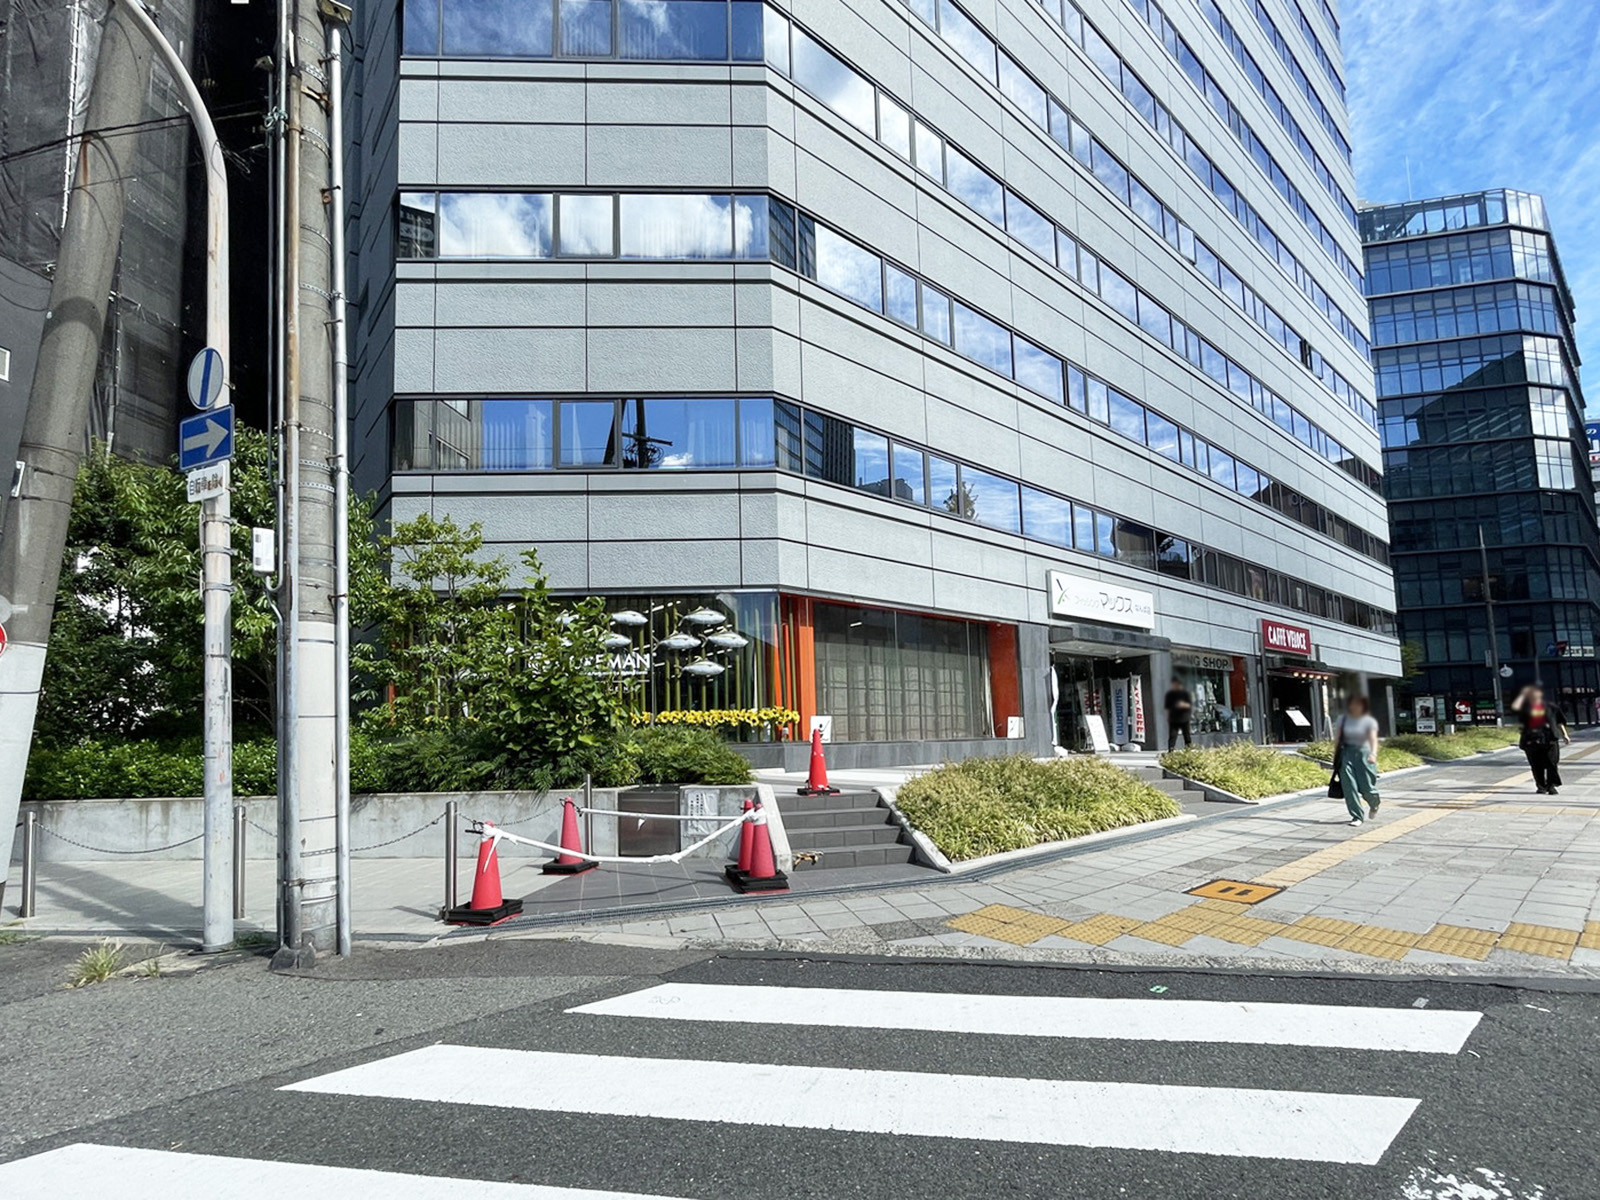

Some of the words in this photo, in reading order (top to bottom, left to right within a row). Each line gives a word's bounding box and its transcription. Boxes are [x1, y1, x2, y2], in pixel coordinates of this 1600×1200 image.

[1286, 629, 1306, 650] VELOCE
[1202, 656, 1229, 669] SHOP
[1115, 688, 1124, 736] SHIMANO
